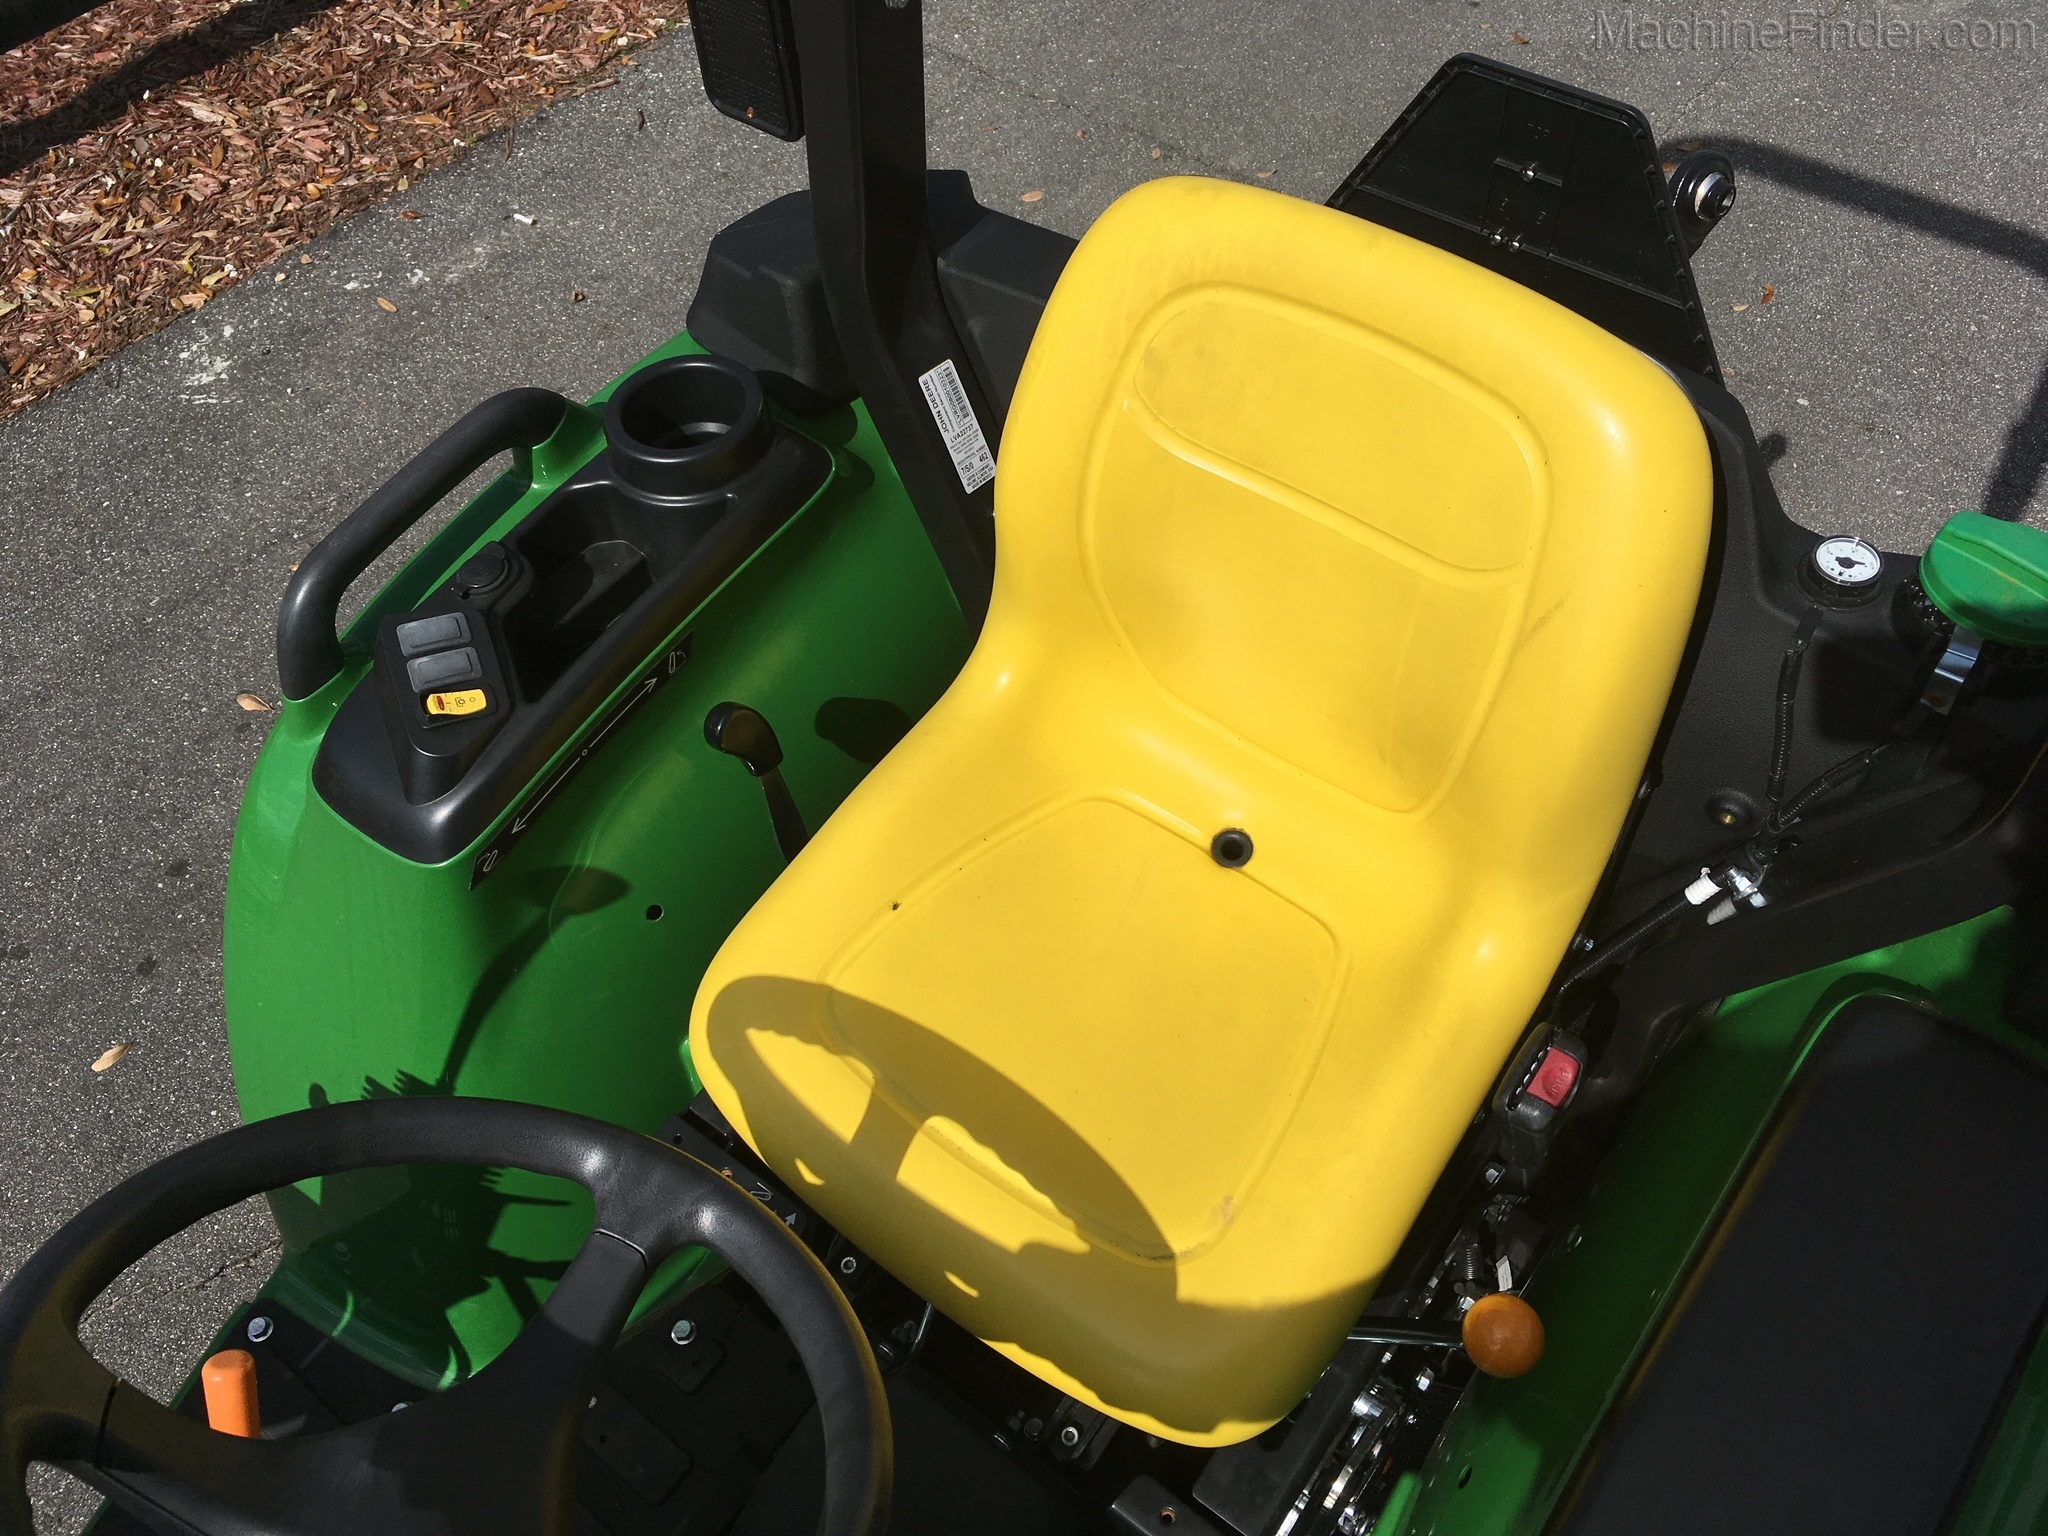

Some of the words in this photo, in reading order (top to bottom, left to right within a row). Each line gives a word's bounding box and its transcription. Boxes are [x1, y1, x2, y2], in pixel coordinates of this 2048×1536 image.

[922, 379, 938, 409] DEERE
[936, 410, 949, 434] JOHN
[949, 423, 974, 443] LVA22737
